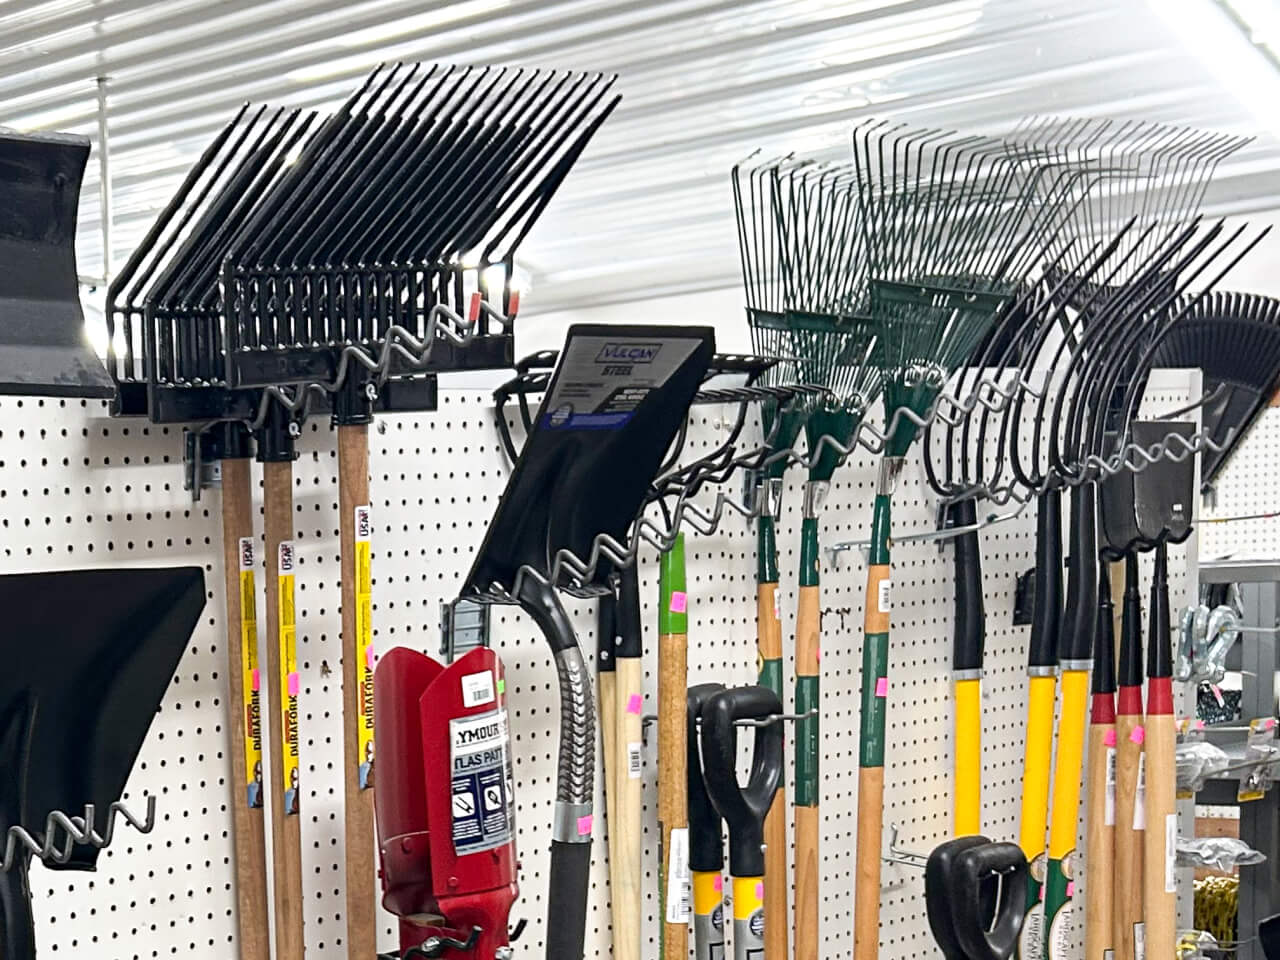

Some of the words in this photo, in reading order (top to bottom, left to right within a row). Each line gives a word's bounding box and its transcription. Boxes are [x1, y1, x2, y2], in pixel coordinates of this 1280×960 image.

[603, 347, 655, 361] VULCAN
[289, 695, 299, 757] DURAFORK
[456, 723, 500, 745] YMOUR
